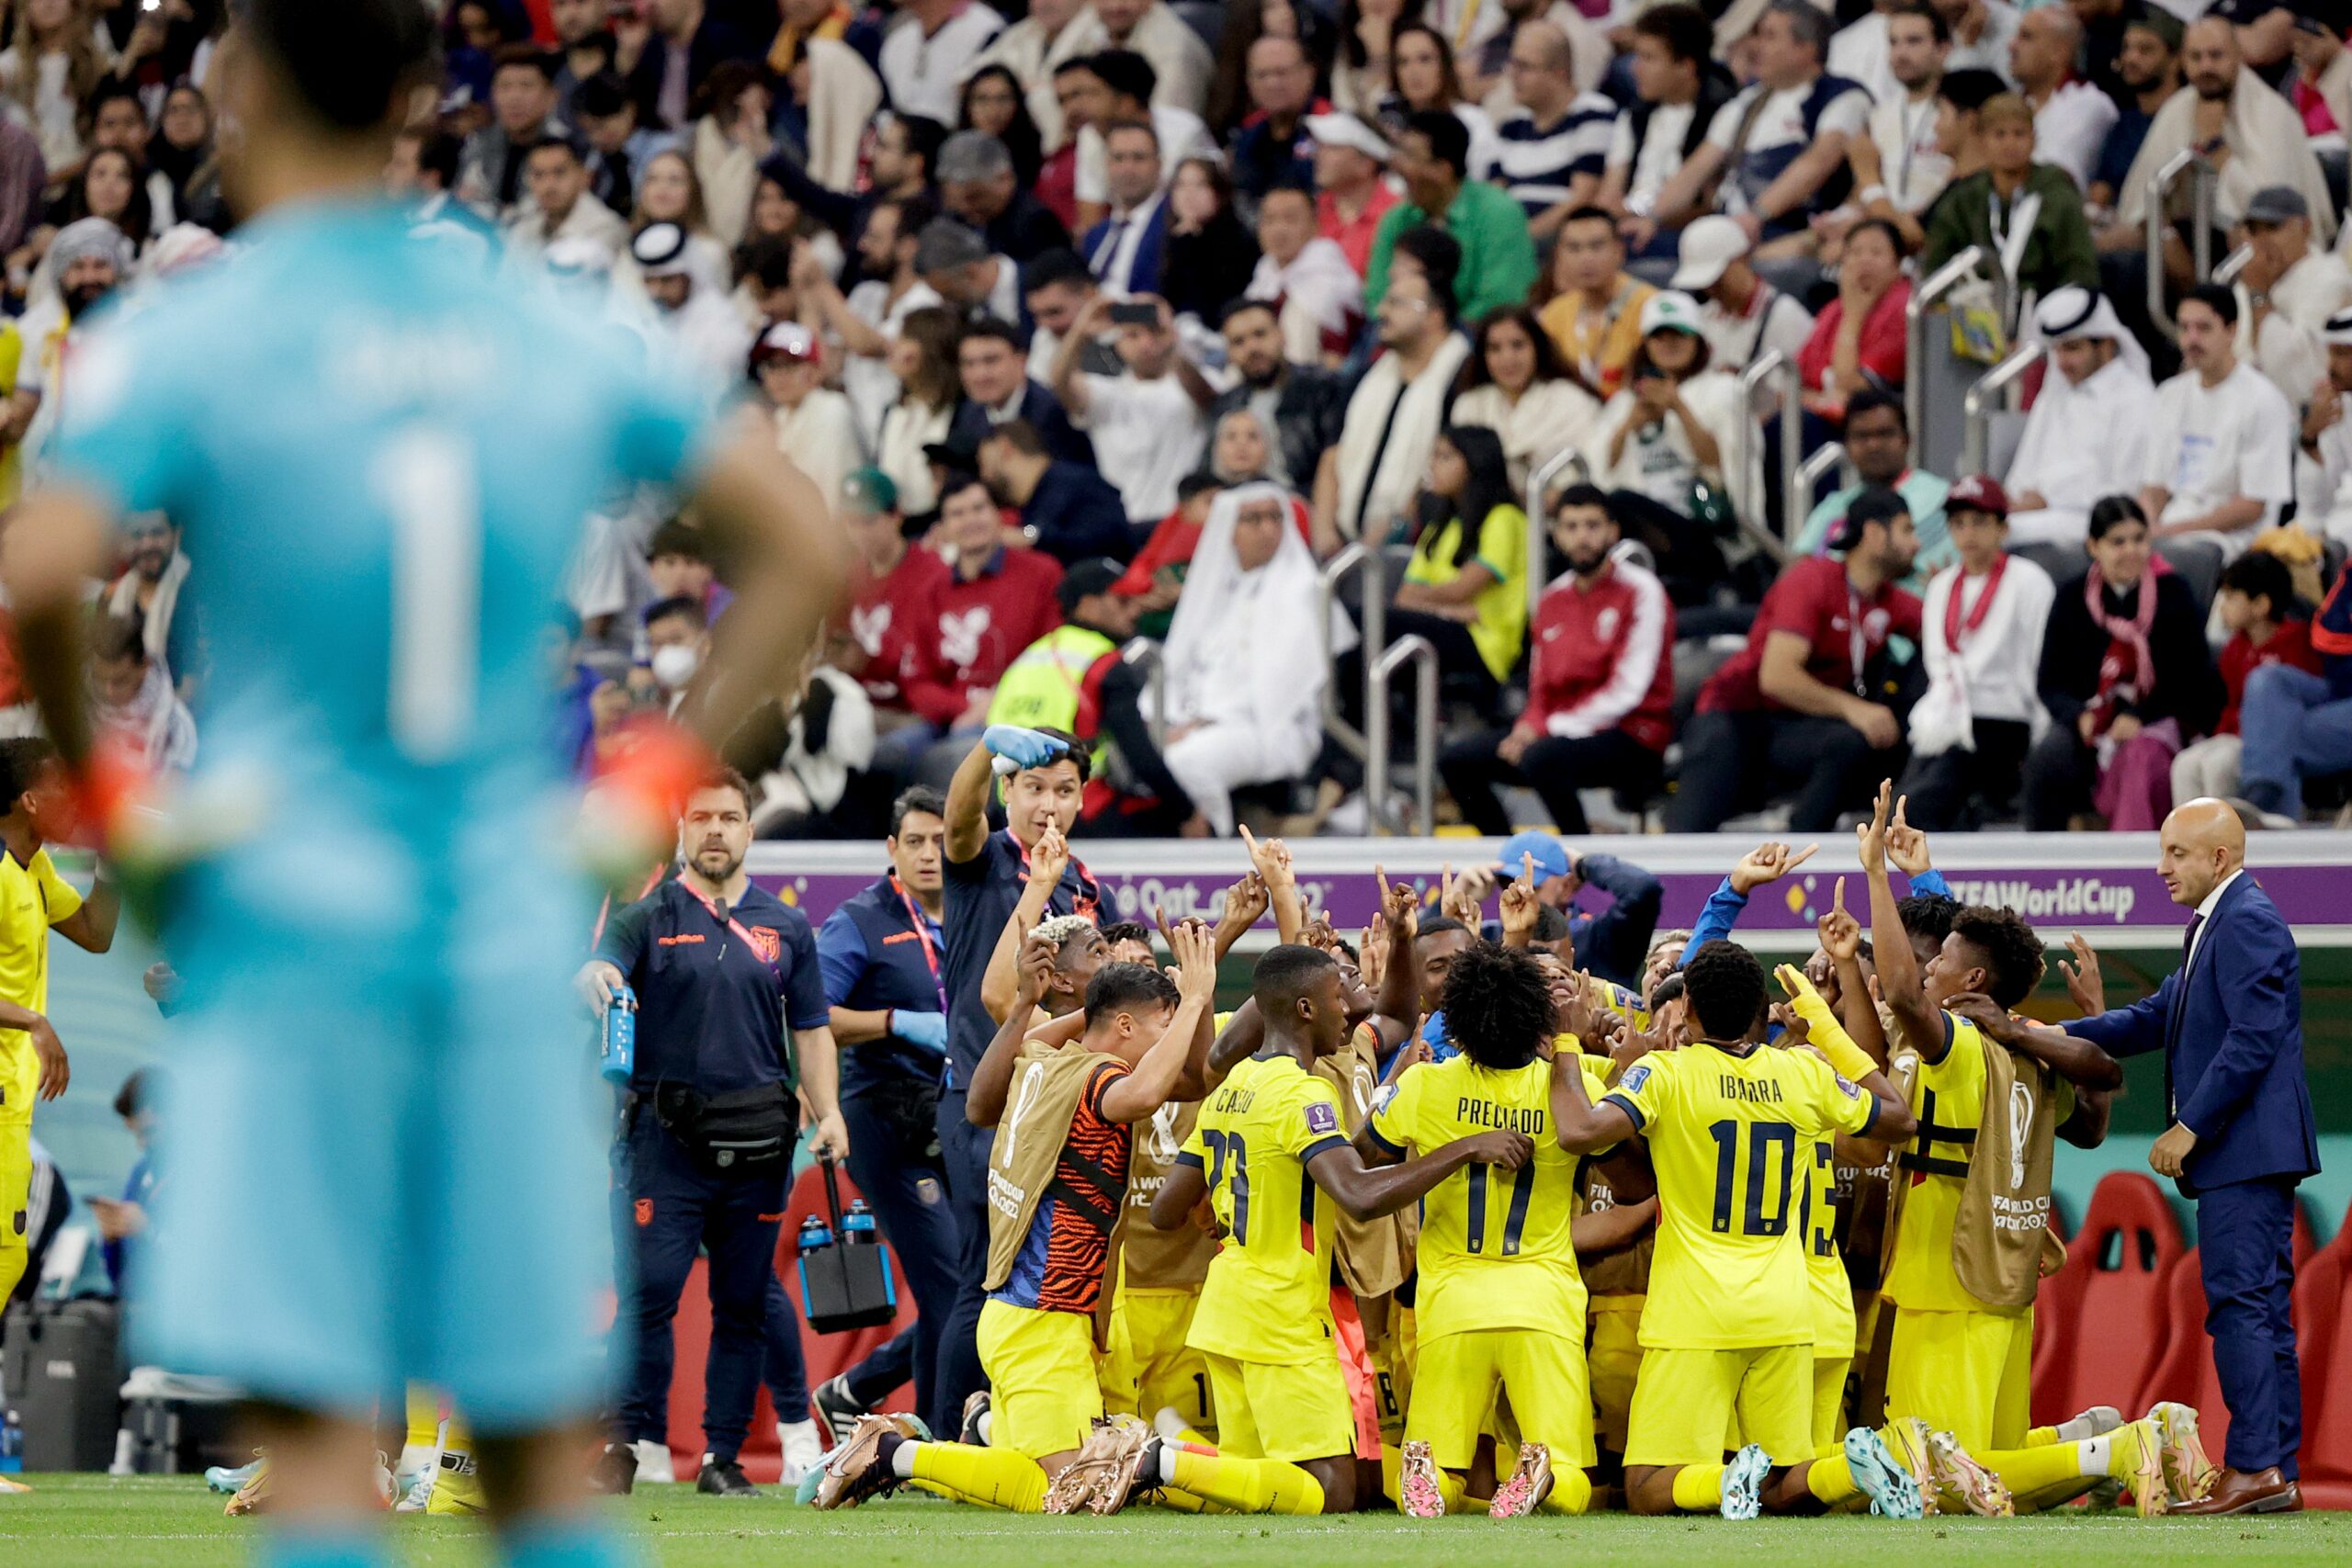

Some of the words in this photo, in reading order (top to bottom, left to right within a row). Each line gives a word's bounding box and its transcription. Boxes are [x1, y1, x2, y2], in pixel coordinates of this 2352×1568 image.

[371, 427, 481, 762] 1
[1457, 1097, 1544, 1134] PRECIADO
[1720, 1075, 1783, 1102] IBARRA
[1202, 1129, 1250, 1247] 23
[1467, 1156, 1535, 1256] 17
[1709, 1119, 1796, 1235] 10
[2035, 1195, 2051, 1210] CU
[1377, 1371, 1399, 1416] 8
